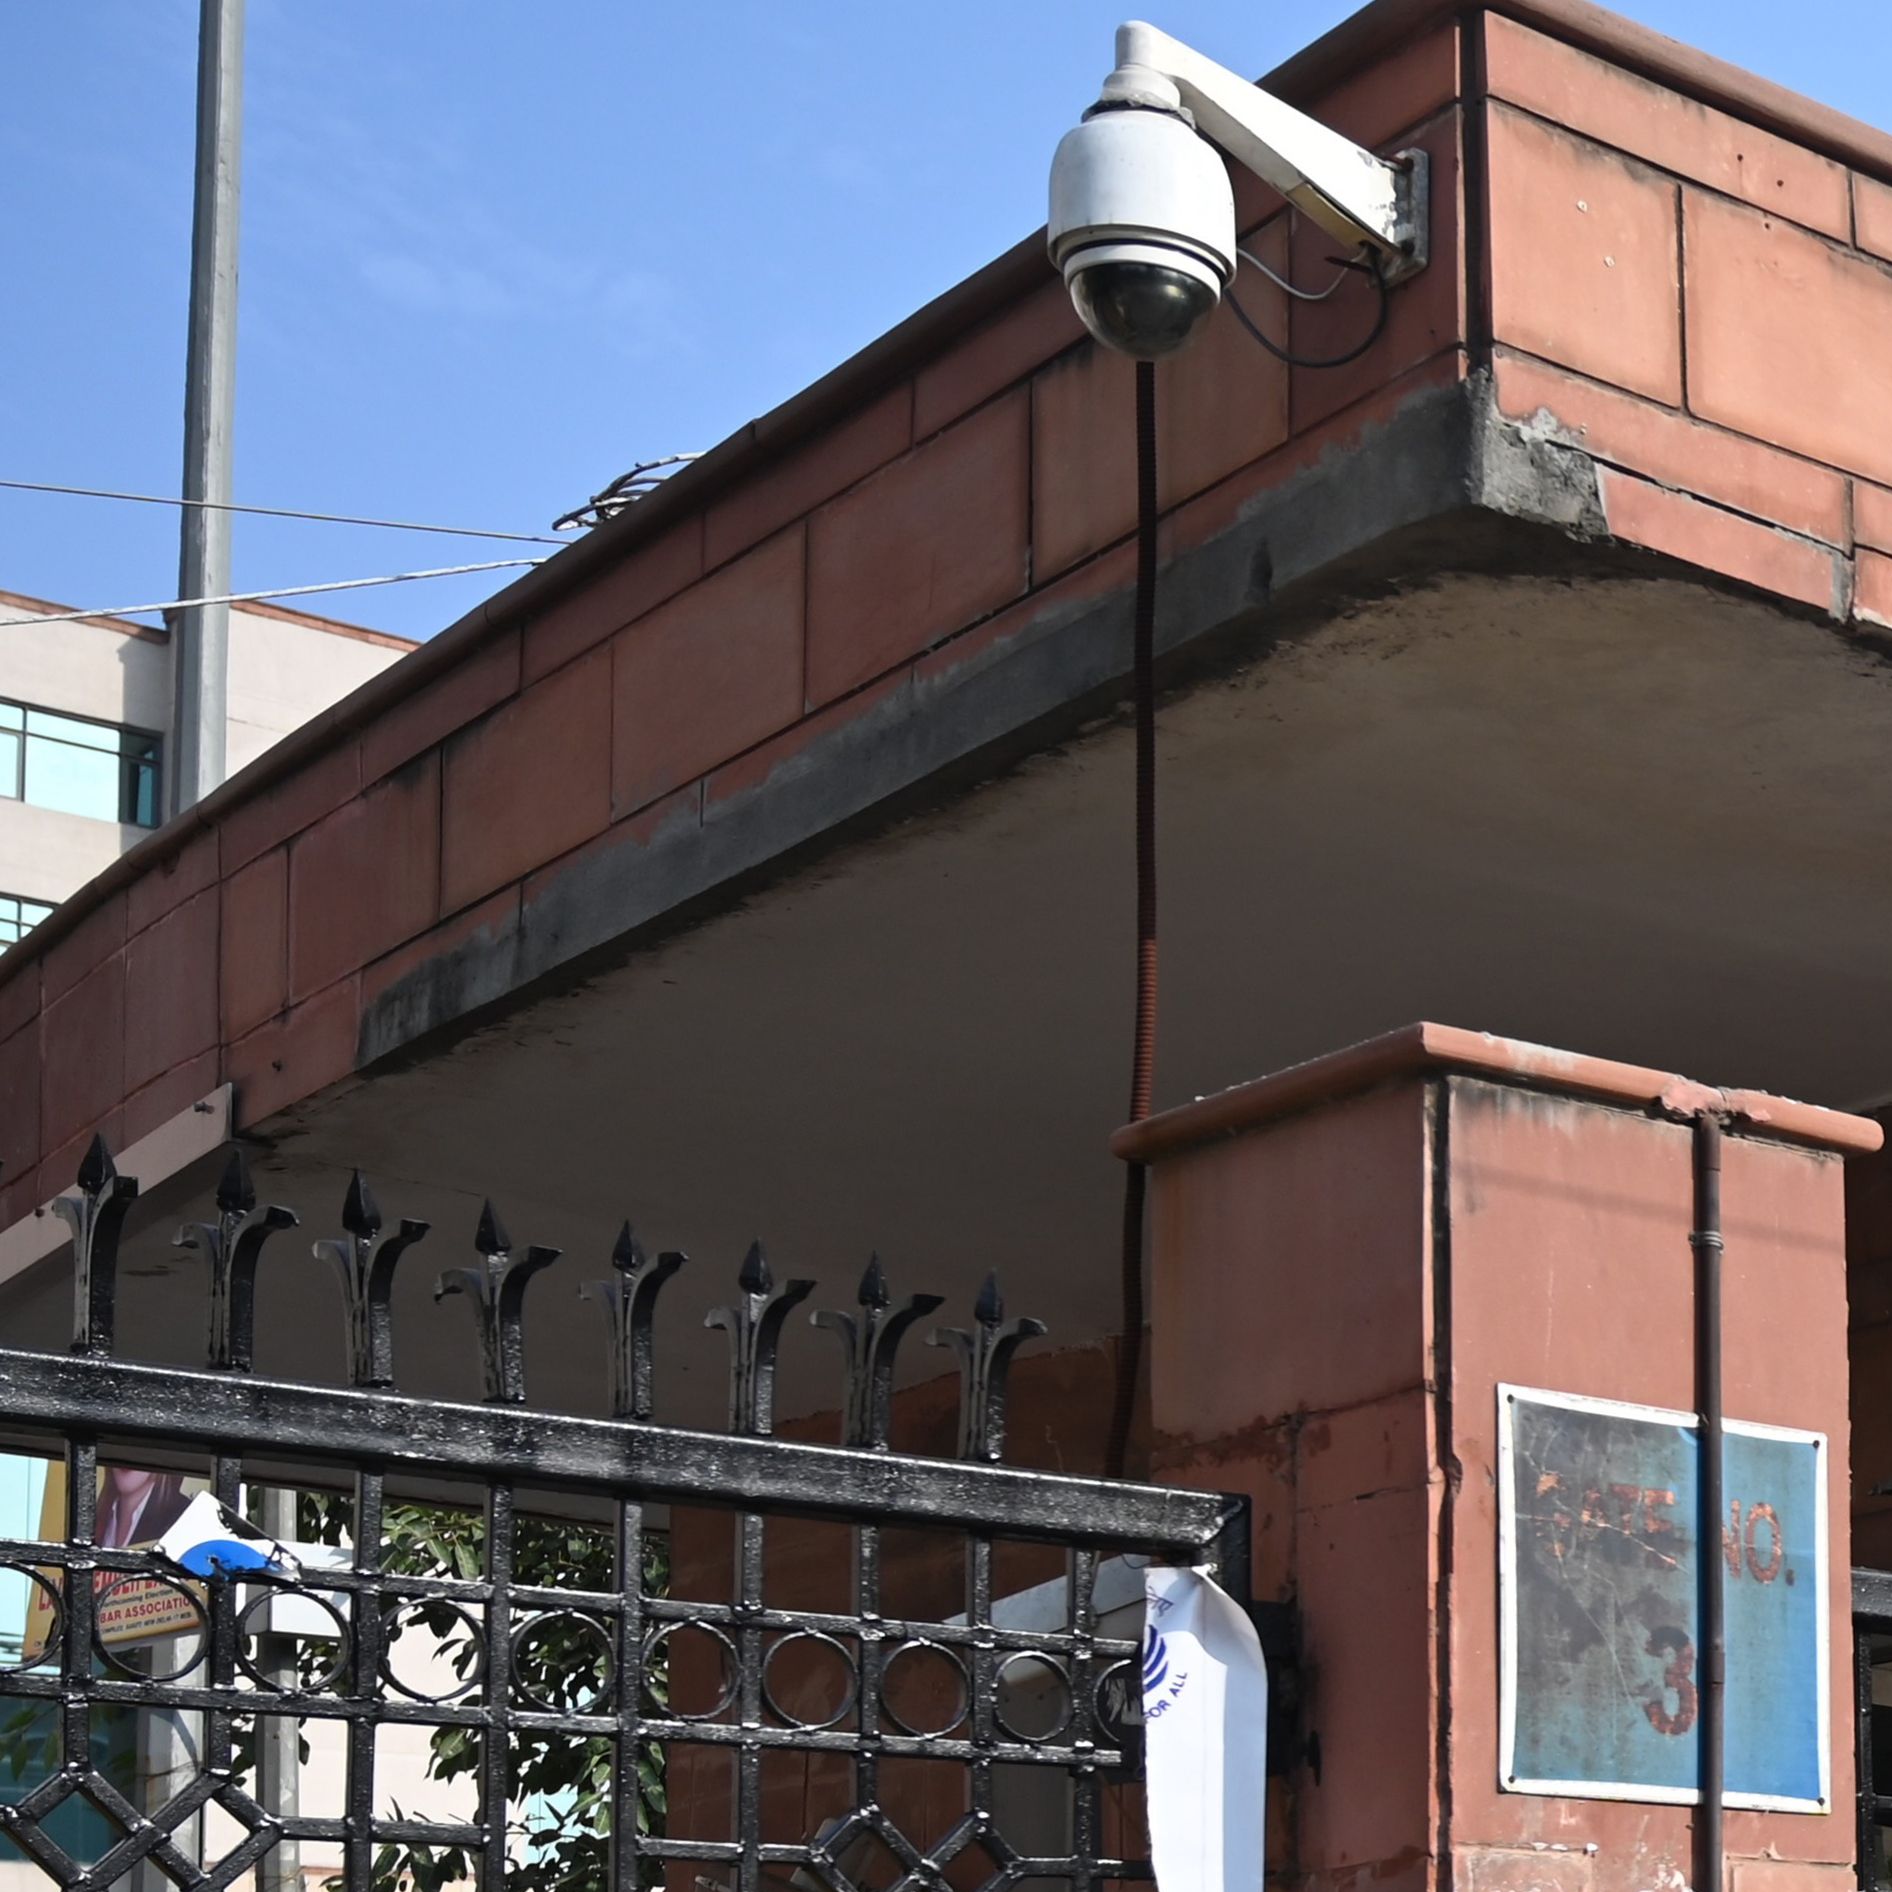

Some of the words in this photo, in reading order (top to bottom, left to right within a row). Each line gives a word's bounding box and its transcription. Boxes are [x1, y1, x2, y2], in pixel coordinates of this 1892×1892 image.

[100, 1609, 122, 1624] BAR
[125, 1597, 191, 1619] ASSOCIATIO
[1169, 1671, 1188, 1698] ALL
[1643, 1626, 1698, 1736] 3
